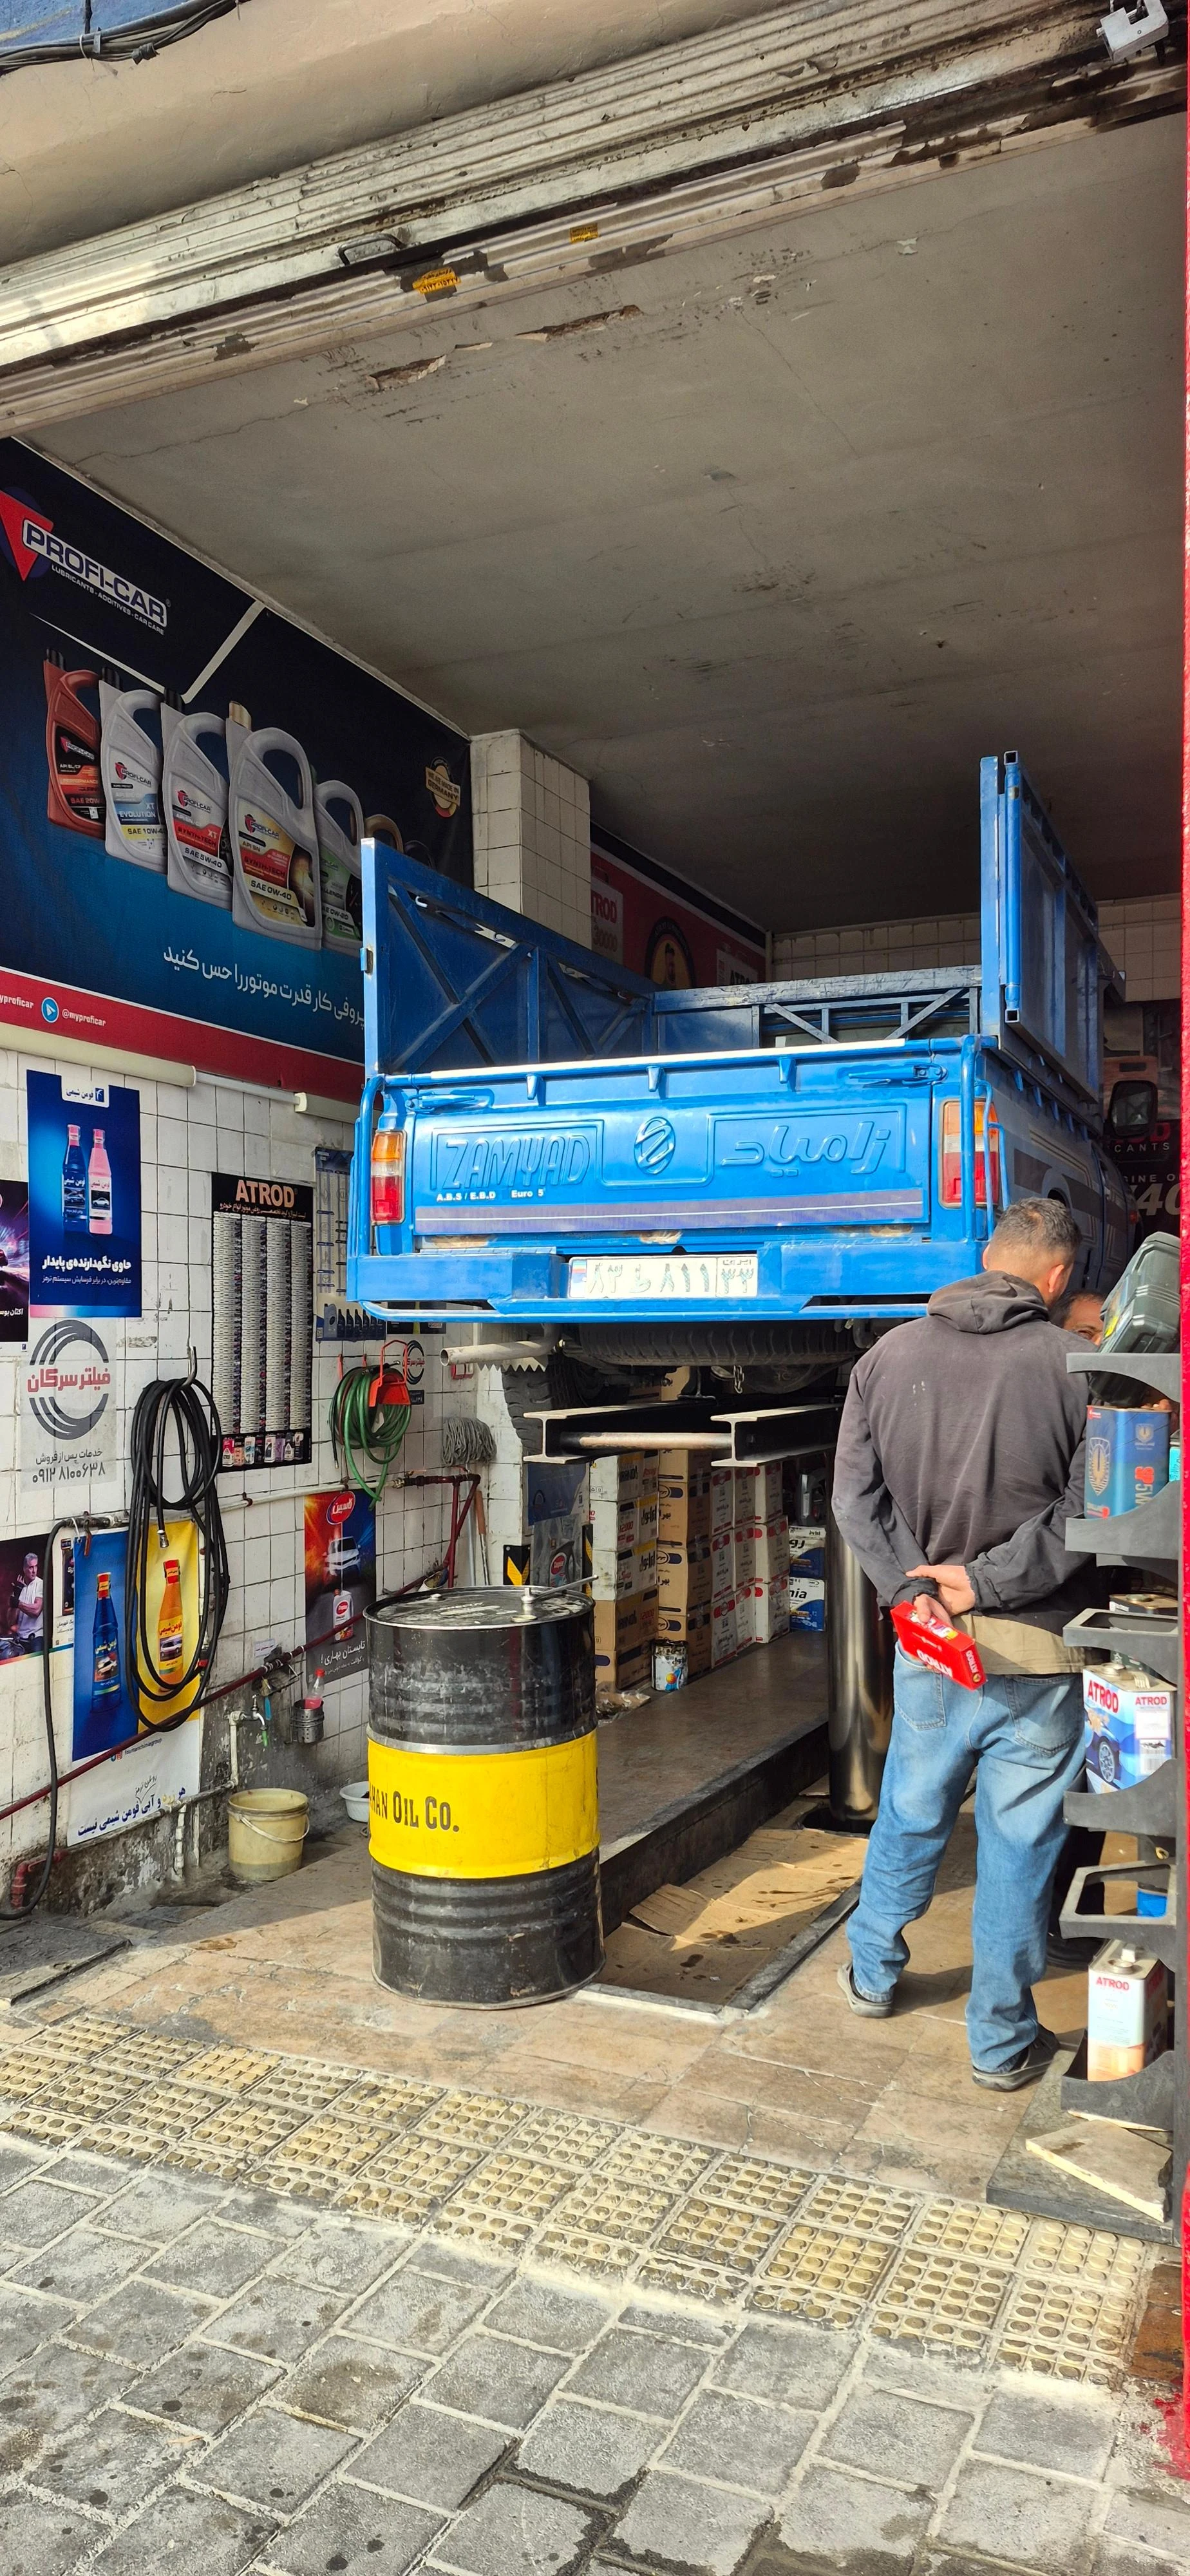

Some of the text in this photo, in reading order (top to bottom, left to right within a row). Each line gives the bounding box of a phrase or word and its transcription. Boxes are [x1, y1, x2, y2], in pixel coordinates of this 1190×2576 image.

[26, 523, 165, 624] PROFI-CAR
[52, 564, 164, 636] LUBRICANTS ADDITIVES CAR CARE
[207, 829, 218, 838] XT
[184, 847, 223, 869] SAE 5W-40
[250, 880, 292, 900] SAE 0W-40
[592, 890, 616, 923] TROD
[163, 946, 200, 971] کنید
[202, 962, 232, 980] حس
[0, 994, 34, 1009] yproficar
[279, 983, 312, 1006] قدرت
[312, 990, 332, 1012] کار
[62, 1009, 106, 1027] @myproficar
[720, 1121, 892, 1178] زامیاد
[1114, 1142, 1170, 1153] CANTS
[442, 1136, 590, 1189] ZAMYAD
[236, 1179, 295, 1208] ATROD
[437, 1193, 462, 1202] A.B.S
[469, 1191, 496, 1200] E.B.D
[511, 1189, 533, 1198] Euro
[538, 1189, 545, 1197] 5
[42, 1255, 65, 1272] پایدار
[111, 1259, 131, 1273] حاوی
[10, 1307, 23, 1316] اکتان
[27, 1366, 111, 1393] فیلتر سرکان
[35, 1449, 102, 1465] خدمات پس از فروش
[32, 1468, 55, 1483] ۰۹۱۲
[324, 1650, 341, 1665] بهاری
[343, 1640, 366, 1660] تابستان
[1088, 1680, 1119, 1714] ATROD
[1135, 1696, 1167, 1706] ATROD
[141, 1794, 155, 1814] آبی
[370, 1783, 388, 1820] HAN
[99, 1810, 120, 1831] شیمی
[122, 1801, 140, 1823] فومن
[77, 1817, 98, 1836] نیست
[1096, 1976, 1129, 1991] ATROD
